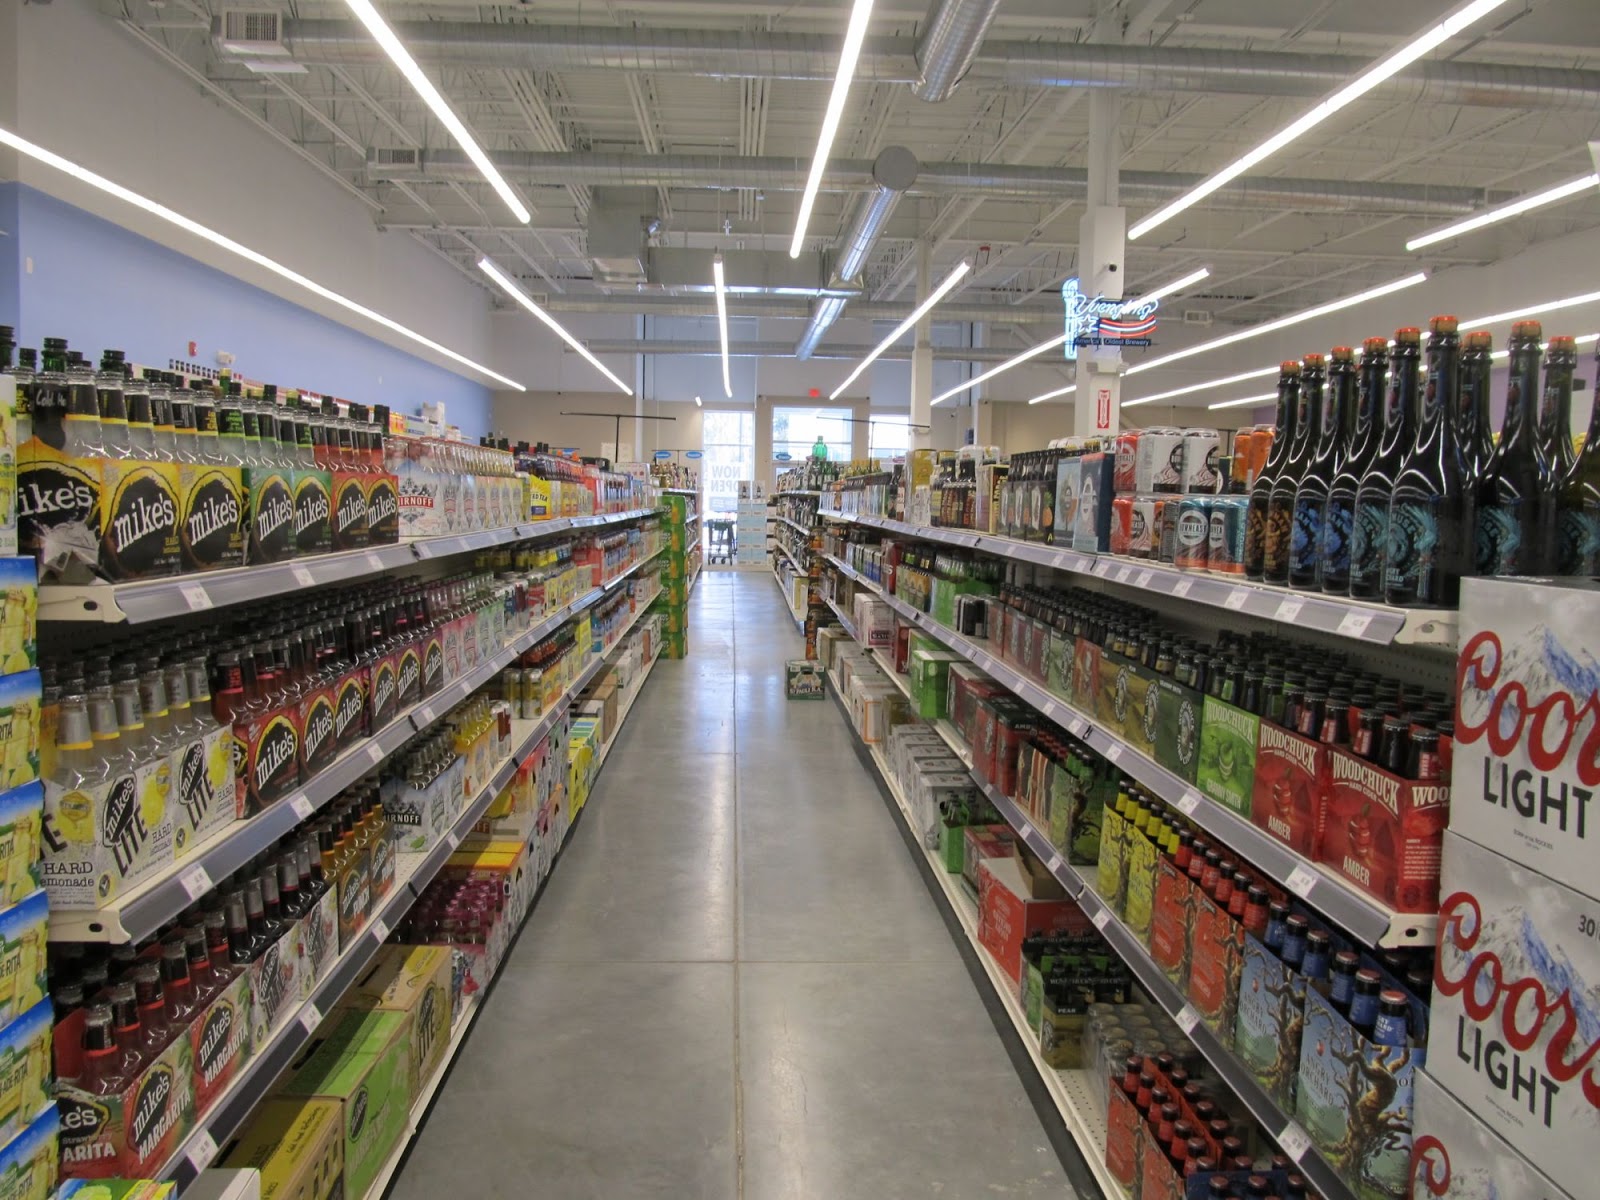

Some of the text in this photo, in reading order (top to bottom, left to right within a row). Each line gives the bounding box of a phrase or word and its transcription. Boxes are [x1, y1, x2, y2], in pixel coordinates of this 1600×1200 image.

[1125, 338, 1149, 346] Brewery
[17, 481, 93, 517] ike's
[189, 494, 238, 546] mike's
[258, 494, 292, 542] mike's
[337, 494, 366, 532] mike's
[368, 493, 397, 529] mike's
[398, 497, 433, 508] IRNOFF
[114, 493, 174, 553] mike's
[374, 674, 395, 716] mike's
[398, 663, 419, 699] mike's
[305, 710, 333, 762] mike's
[335, 692, 361, 738] mike's
[1206, 700, 1255, 745] WOODCHUCK
[181, 743, 203, 799] mike's
[256, 730, 294, 790] mike's
[1260, 723, 1317, 776] WOODCHUCK
[1332, 752, 1400, 815] WOODCHUCK
[1349, 782, 1378, 802] HARD CIDER
[1483, 756, 1593, 840] LIGHT
[105, 776, 134, 842] mike's
[384, 812, 421, 825] IRNOFF
[1268, 815, 1291, 841] AMBER
[112, 803, 148, 877] LITE
[152, 823, 172, 844] HARD
[40, 877, 94, 887] emonade
[43, 861, 93, 875] HARD
[1342, 855, 1370, 887] AMBER
[200, 1005, 230, 1067] mike's
[204, 1024, 248, 1087] MARGARITA
[1457, 1015, 1560, 1129] LIGHT
[134, 1074, 170, 1141] mike's
[139, 1087, 191, 1164] MARGARITA
[64, 1142, 116, 1162] ARITA
